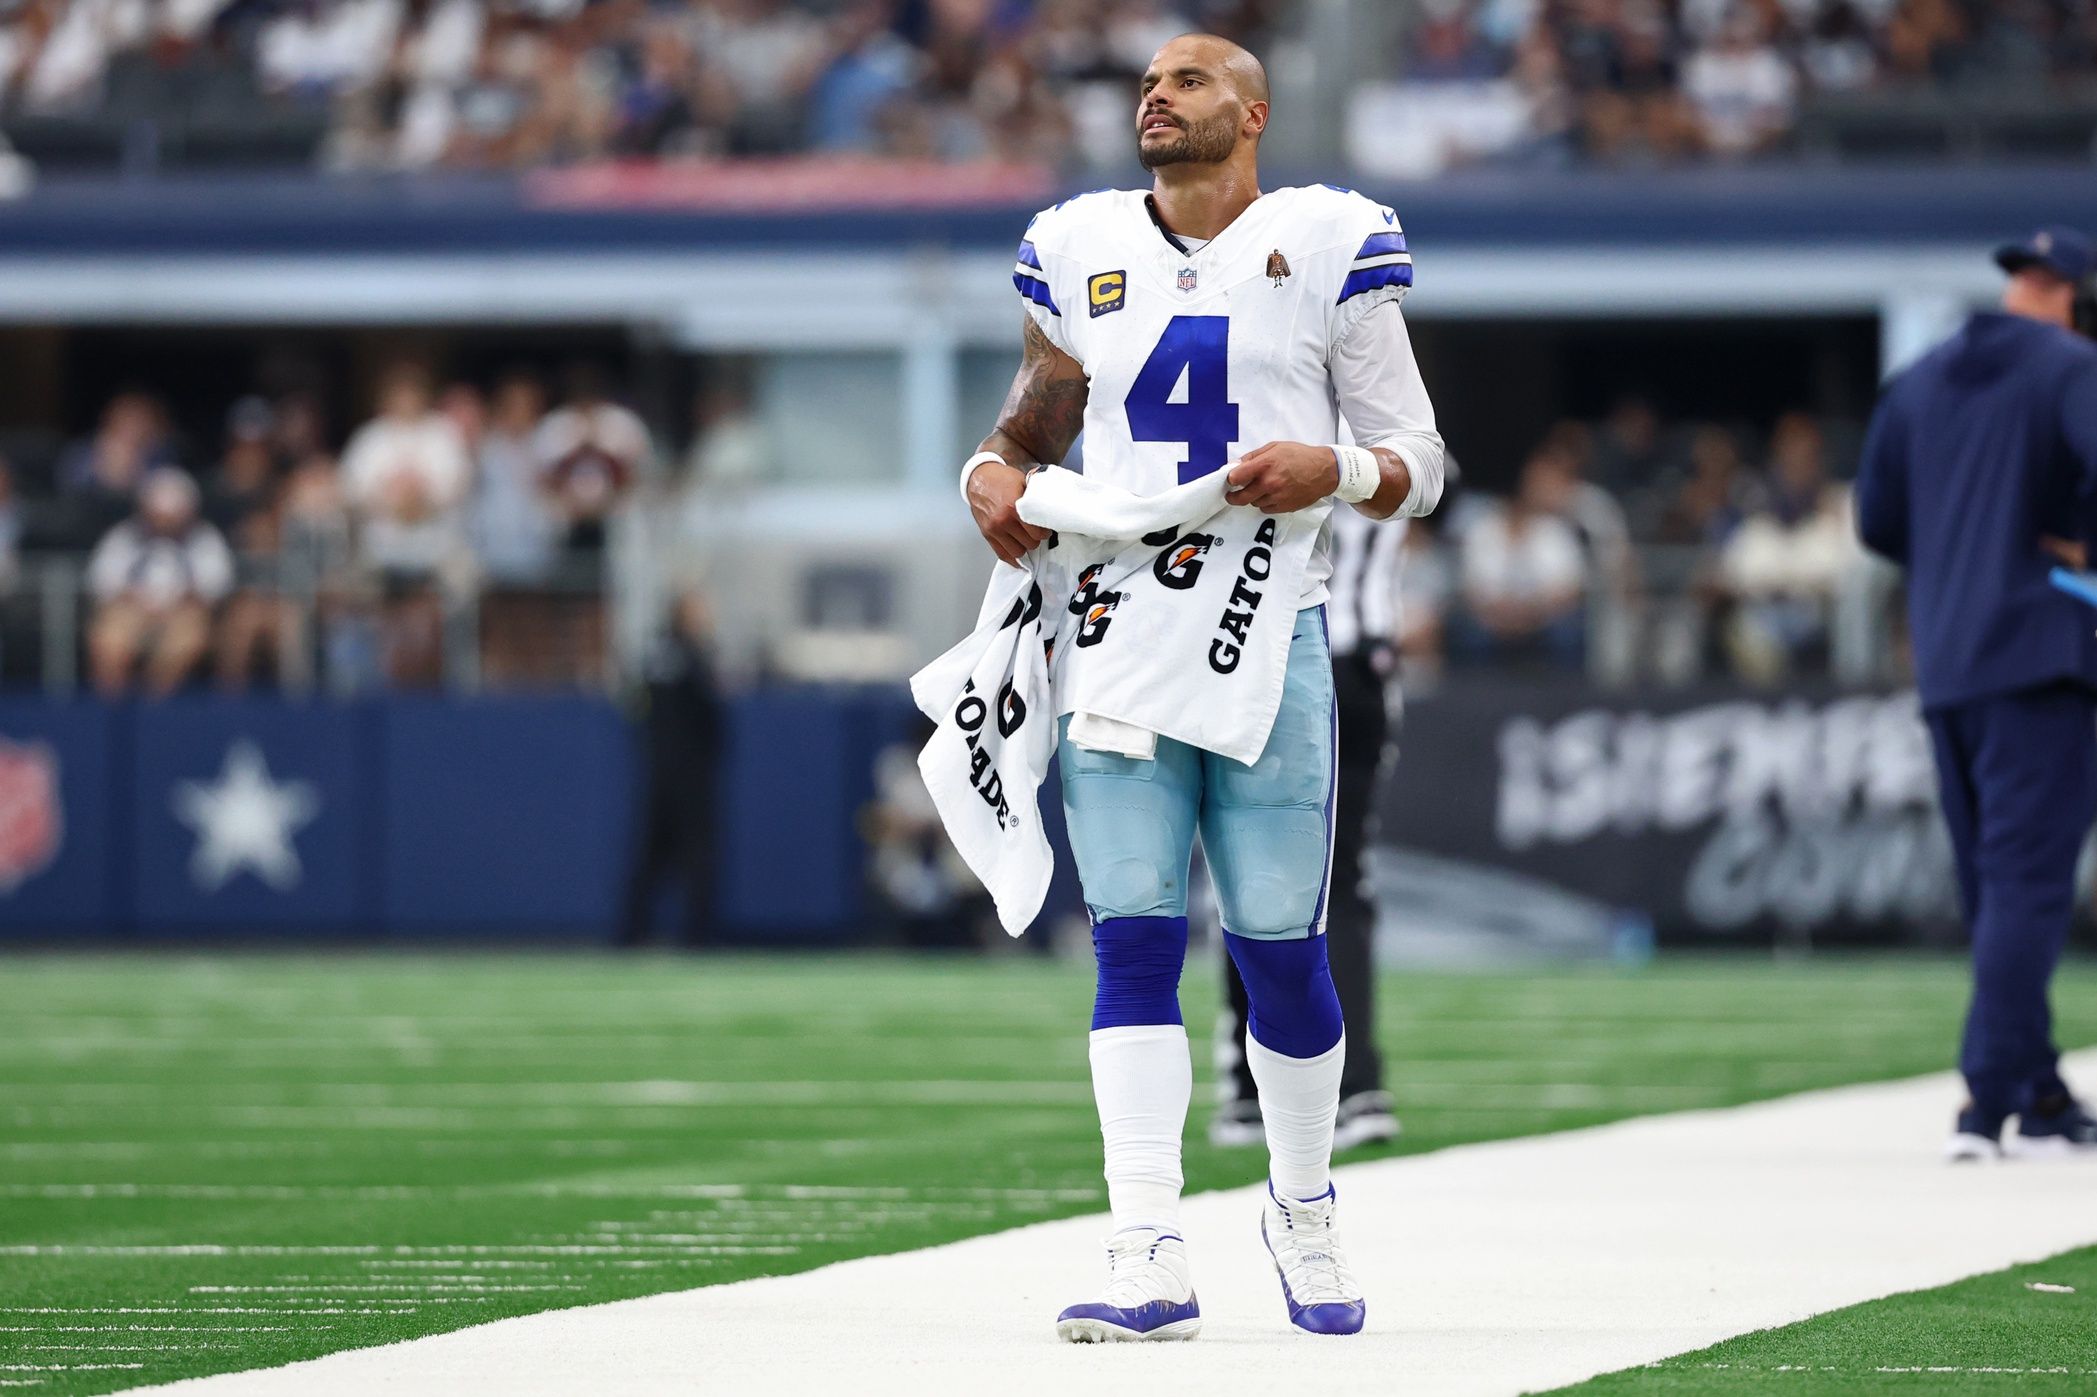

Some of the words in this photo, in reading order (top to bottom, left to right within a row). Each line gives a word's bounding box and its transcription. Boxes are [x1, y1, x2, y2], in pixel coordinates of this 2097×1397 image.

[1091, 273, 1123, 304] C
[1124, 315, 1239, 486] 4
[1153, 532, 1215, 590] G
